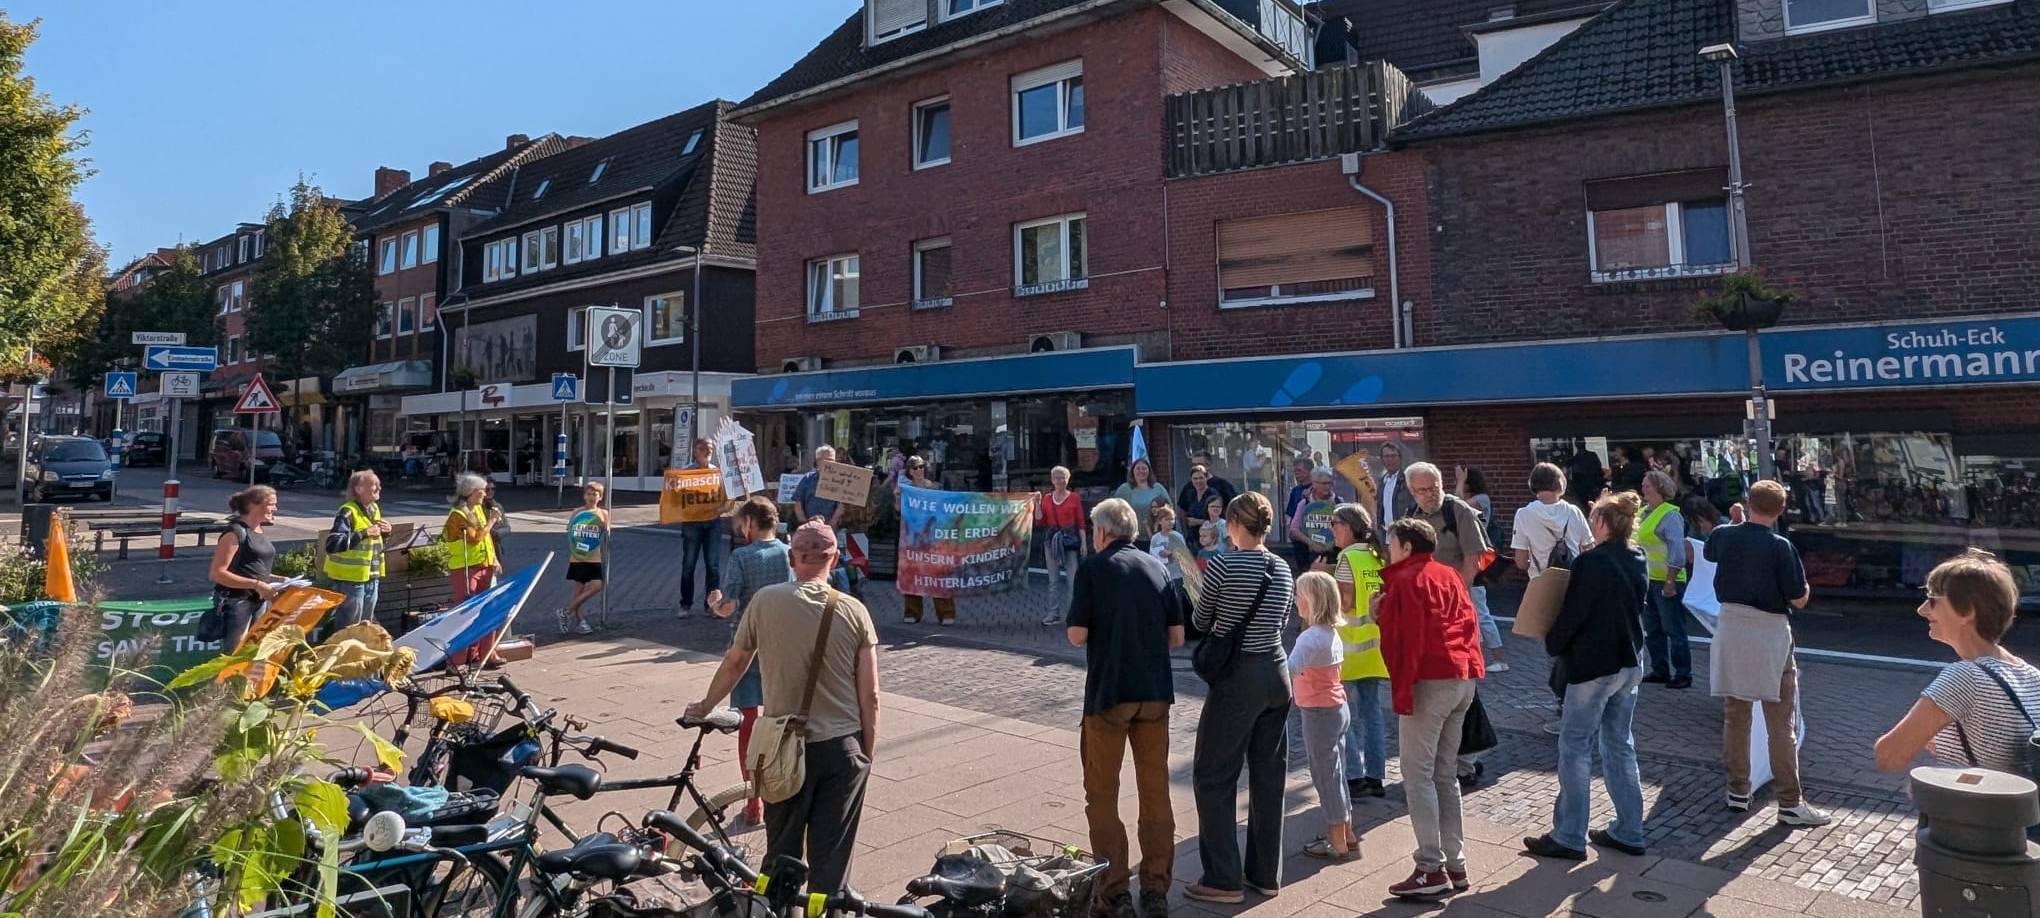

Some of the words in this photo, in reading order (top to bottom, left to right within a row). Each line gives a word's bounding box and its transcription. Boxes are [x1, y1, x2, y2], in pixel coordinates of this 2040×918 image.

[136, 334, 179, 342] Viktorstraße
[1887, 327, 2005, 349] Schuh-Eck
[603, 352, 629, 361] ZONE
[1784, 350, 2040, 383] Reinermann
[908, 497, 937, 511] WIE
[943, 503, 995, 514] WOLLEN
[934, 529, 958, 539] DIE
[965, 527, 998, 538] ERDE
[906, 550, 954, 565] UNSERN
[961, 545, 1015, 564] KINDERN
[914, 570, 1013, 588] HINTERLASSEN?
[100, 610, 205, 631] STOP
